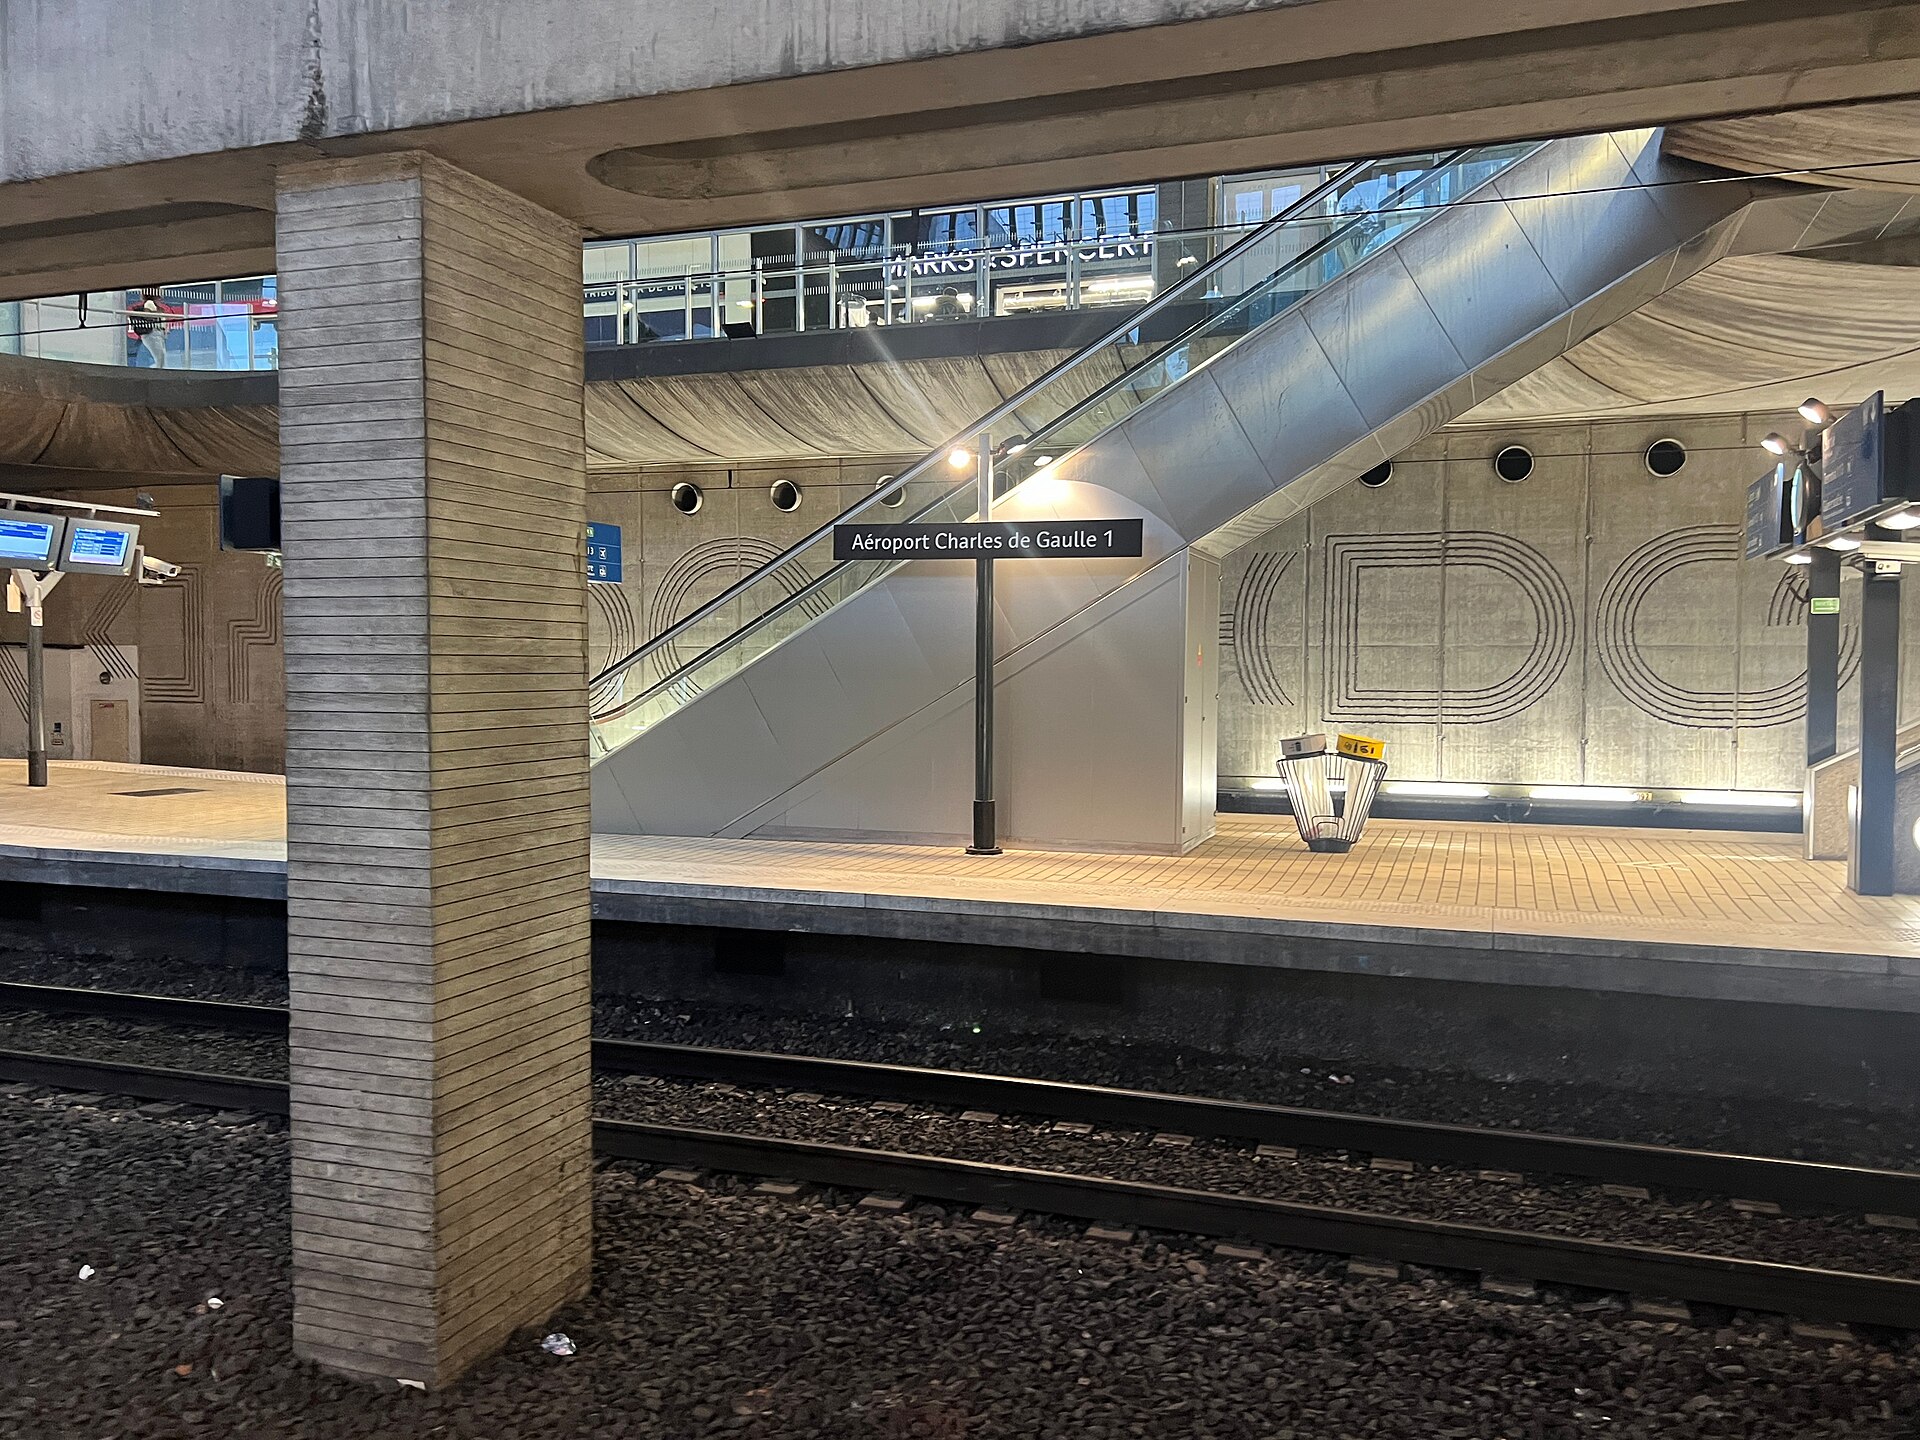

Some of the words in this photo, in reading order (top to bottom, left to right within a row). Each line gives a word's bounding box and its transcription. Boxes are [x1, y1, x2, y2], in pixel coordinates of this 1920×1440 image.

[851, 532, 930, 554] Aéroport
[935, 531, 1003, 550] Charles
[1008, 530, 1031, 549] de
[1036, 530, 1097, 549] Gaulle
[1103, 529, 1113, 548] 1
